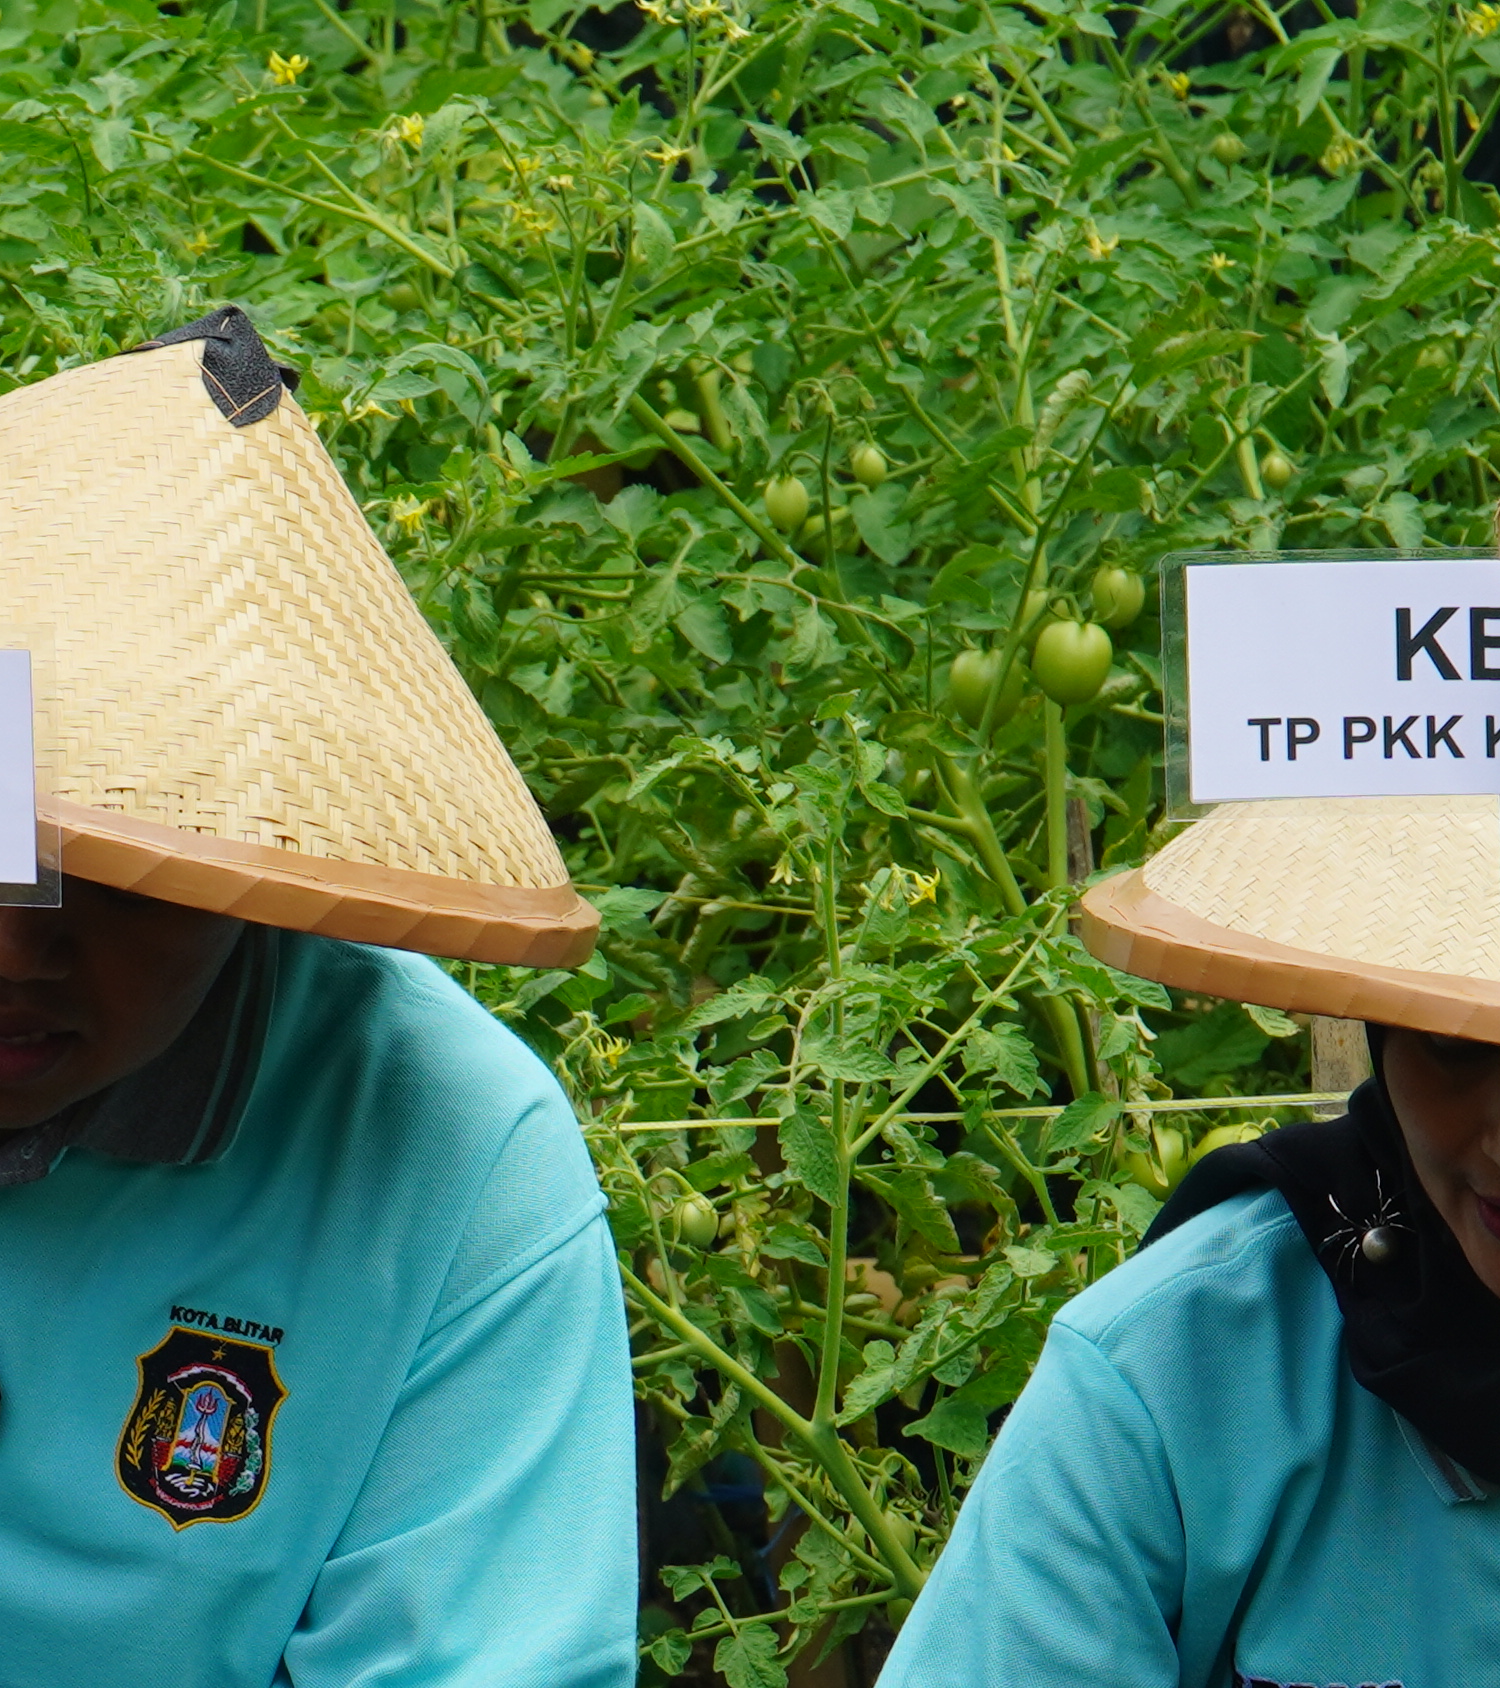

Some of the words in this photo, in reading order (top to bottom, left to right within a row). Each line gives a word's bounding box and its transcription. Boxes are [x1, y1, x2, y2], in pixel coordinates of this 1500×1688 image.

[1246, 716, 1321, 763] TP
[1342, 714, 1466, 761] PKK
[169, 1305, 219, 1330] KOTA
[222, 1316, 285, 1345] BLITAR
